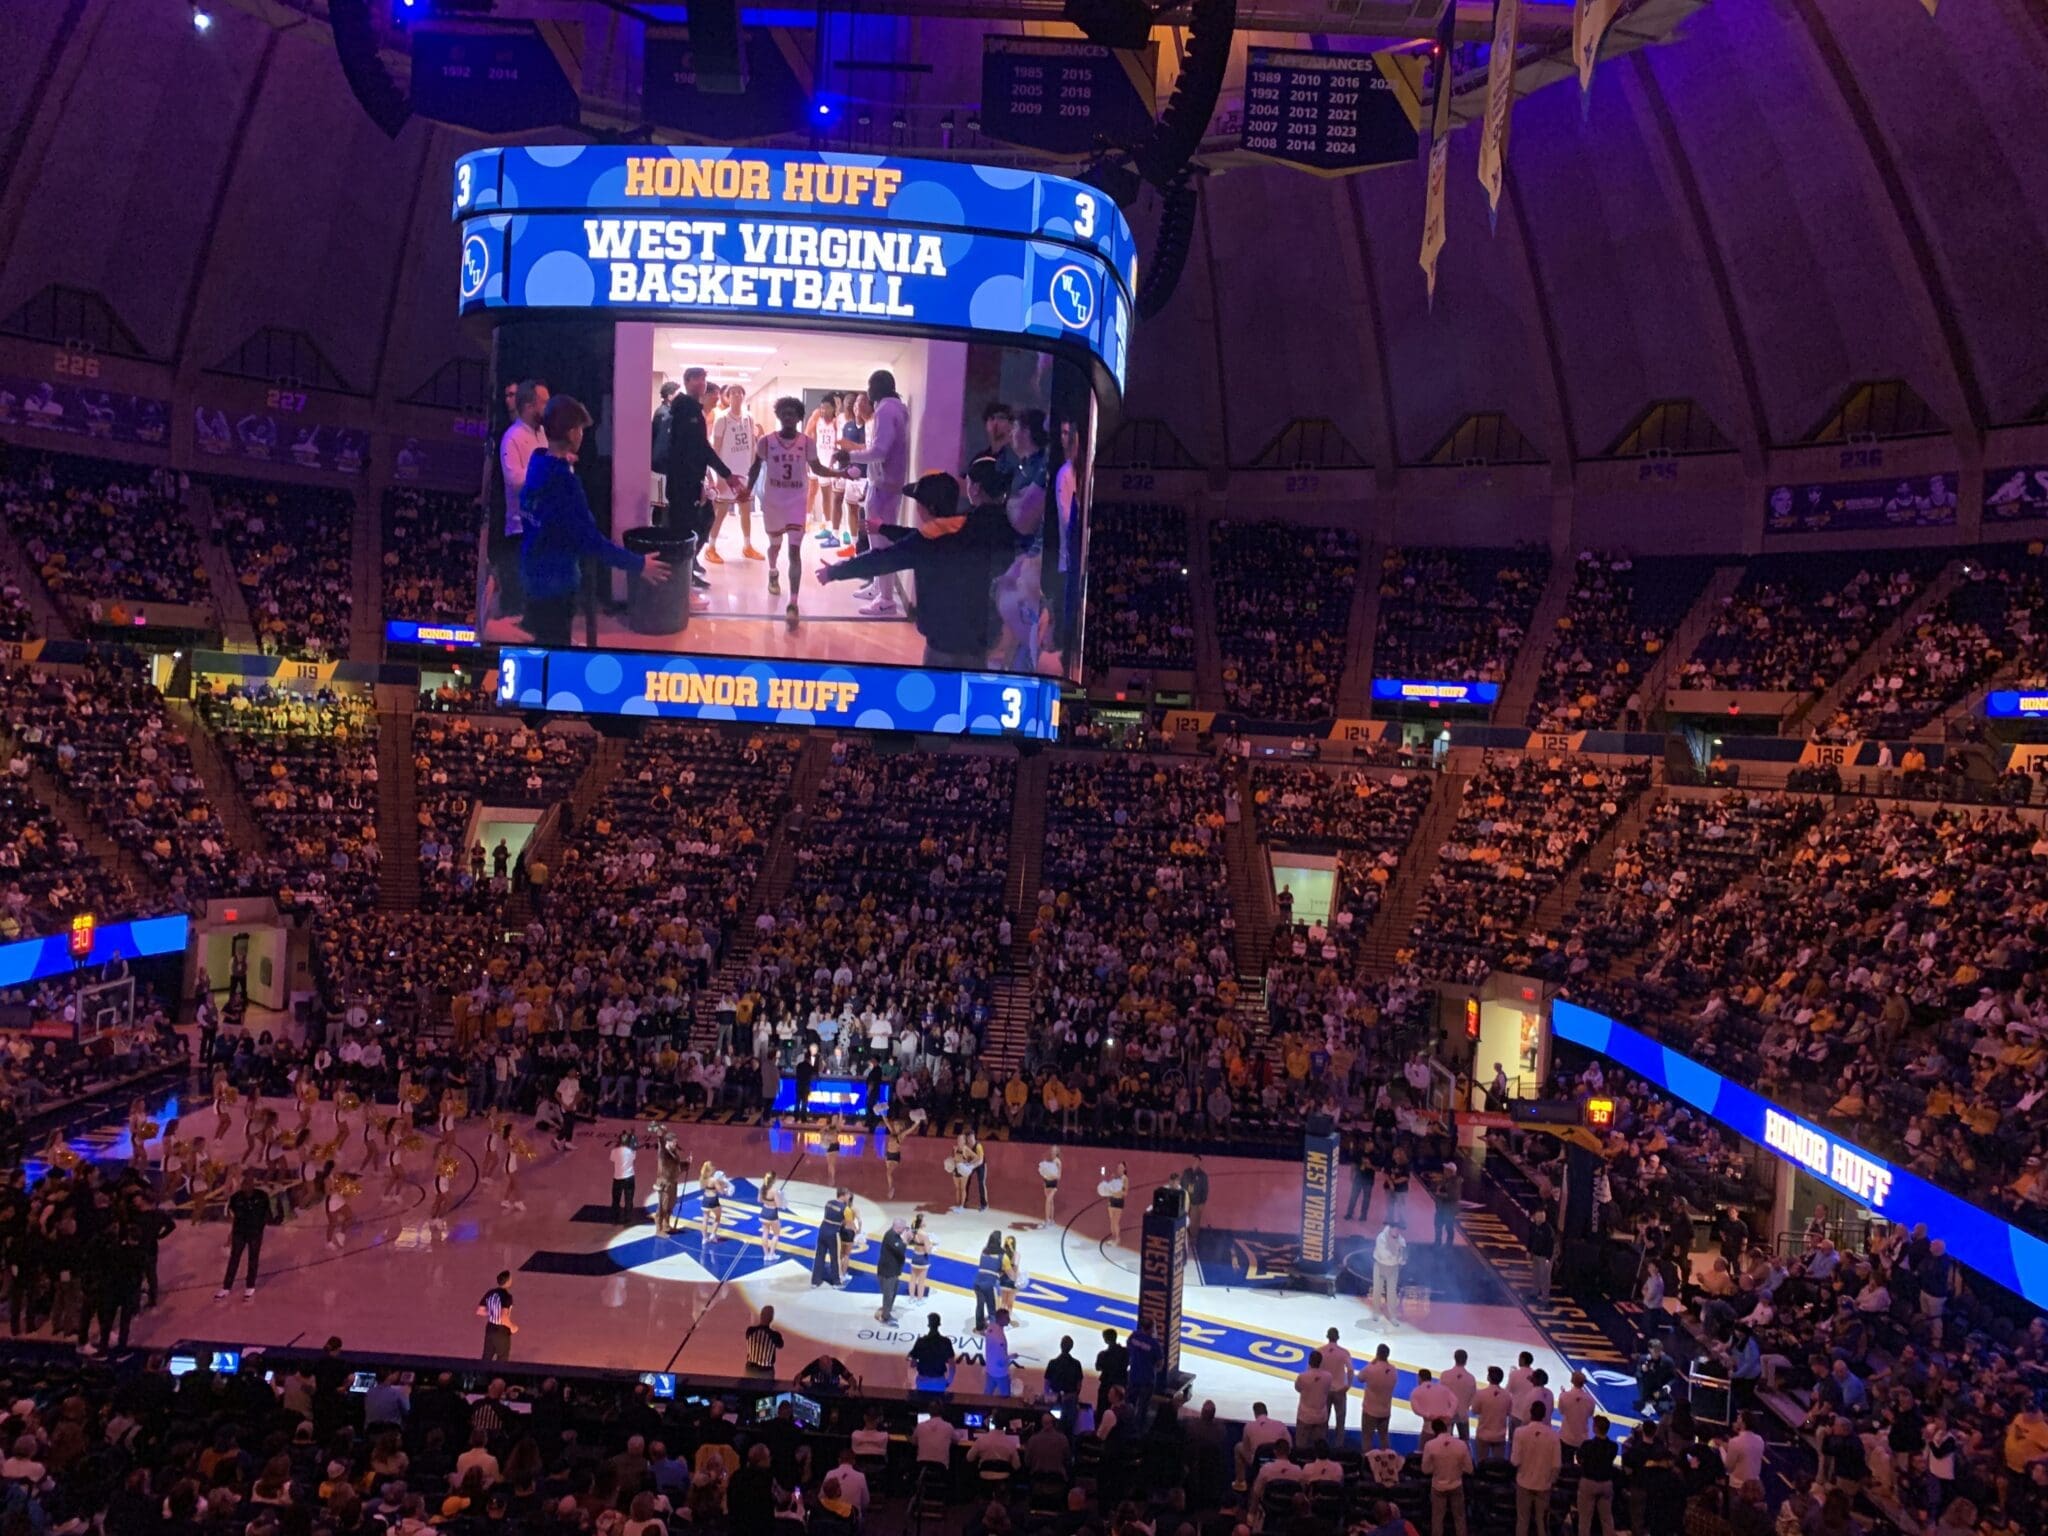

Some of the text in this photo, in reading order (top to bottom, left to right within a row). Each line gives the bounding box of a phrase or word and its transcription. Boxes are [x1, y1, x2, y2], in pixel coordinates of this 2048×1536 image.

[1273, 55, 1373, 72] APPEARANCES
[487, 68, 518, 80] 2014
[1013, 66, 1092, 81] 1985 2015
[1252, 71, 1281, 83] 1989
[1291, 73, 1321, 86] 2010
[1330, 76, 1360, 88] 2016
[1011, 84, 1091, 98] 2005 2018
[1250, 88, 1359, 105] 1992 2011 2017
[1010, 102, 1090, 117] 2009 2019
[1249, 104, 1357, 121] 2004 2012 2021
[1248, 121, 1356, 137] 2007 2013 2023
[1247, 137, 1356, 154] 2008 2014 2024
[457, 164, 471, 207] 3
[625, 157, 902, 208] HONOR HUFF
[1073, 192, 1096, 238] 3
[583, 219, 947, 277] WEST VIRGINIA
[608, 262, 915, 318] BASKETBALL
[1061, 274, 1087, 322] WVU
[734, 433, 748, 445] 52
[782, 464, 792, 480] 3
[297, 665, 318, 680] 119
[501, 658, 515, 699] 3
[645, 670, 859, 713] HONOR HUFF
[1000, 687, 1021, 728] 3
[1176, 718, 1199, 732] 123
[1345, 726, 1370, 740] 124
[1542, 736, 1568, 751] 125
[1817, 748, 1844, 764] 126
[2026, 754, 2048, 773] 12
[73, 928, 89, 949] 30
[1593, 1111, 1608, 1122] 30
[1765, 1108, 1893, 1208] HONOR HUFF
[1302, 1151, 1328, 1263] WEST VIRGINIA
[1455, 1212, 1527, 1252] HOPE
[1143, 1234, 1170, 1286] WEST
[857, 1328, 984, 1351] Mecine
